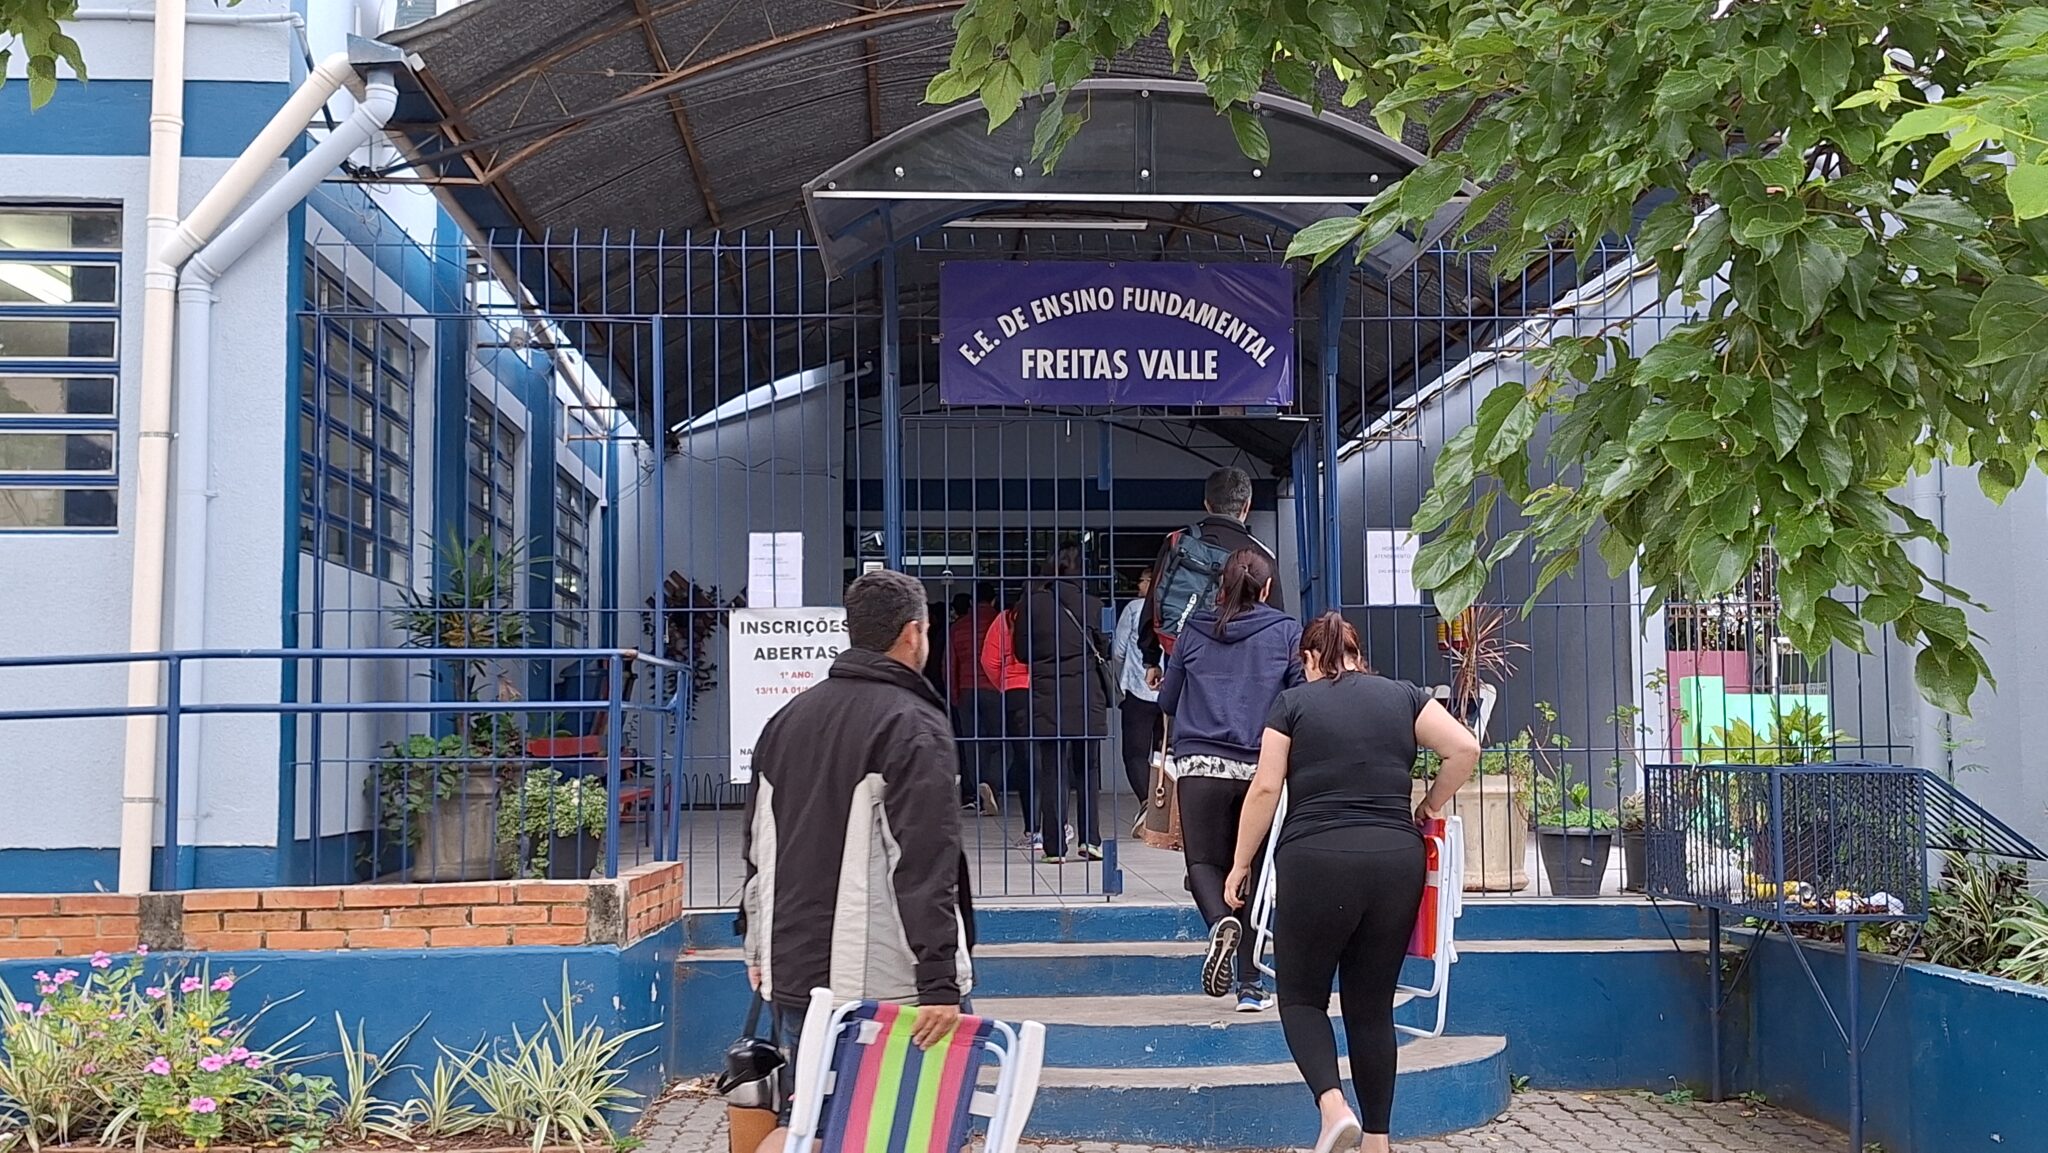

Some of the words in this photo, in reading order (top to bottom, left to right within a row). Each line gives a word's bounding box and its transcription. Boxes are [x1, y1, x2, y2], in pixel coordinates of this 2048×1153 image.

[958, 329, 1001, 366] E.E.
[997, 306, 1030, 339] DE
[1030, 287, 1115, 324] ENSINO
[1122, 287, 1276, 368] FUNDAMENTAL
[1021, 349, 1129, 380] FREITAS
[1138, 349, 1218, 380] VALLE
[740, 617, 849, 637] INSCRIÇÕES
[753, 646, 839, 661] ABERTAS
[791, 671, 814, 679] ANO:
[755, 686, 779, 695] 13/11
[782, 686, 789, 694] A
